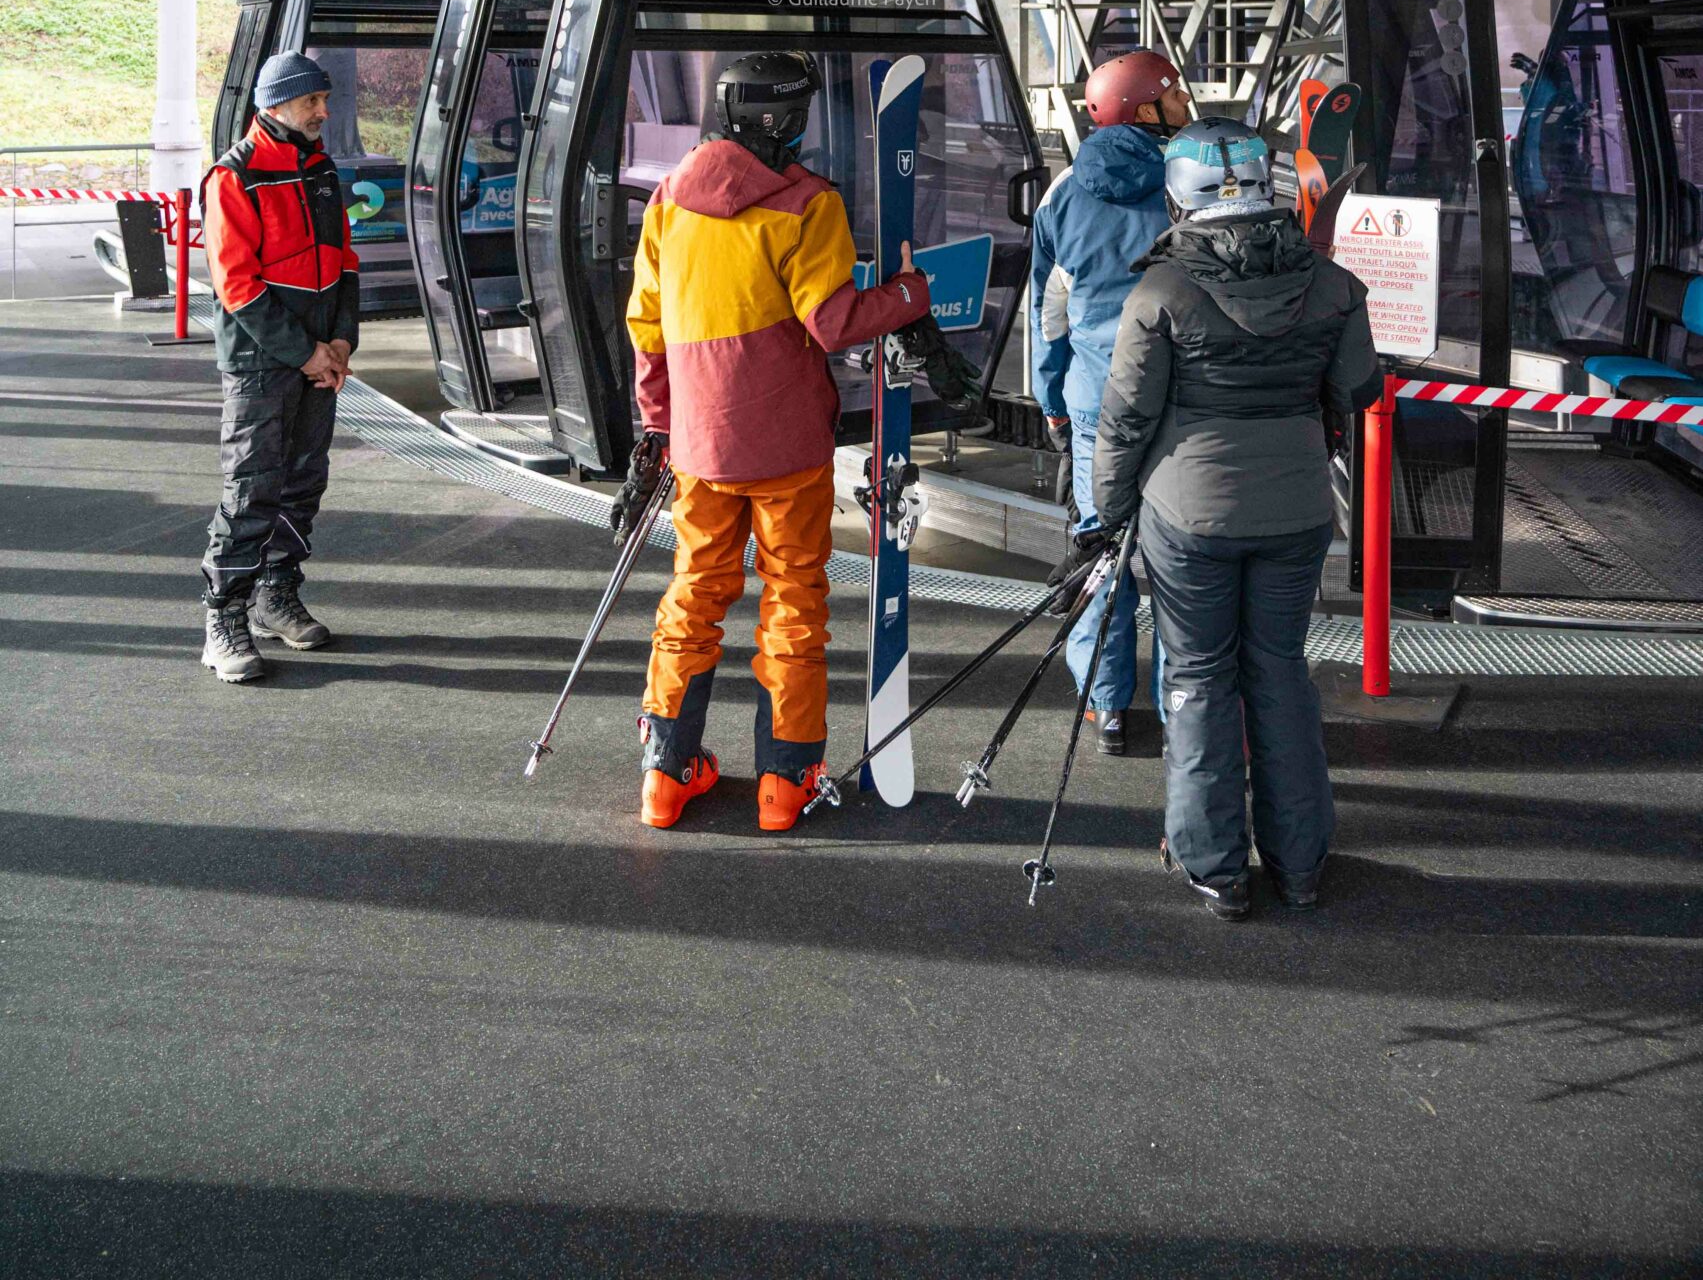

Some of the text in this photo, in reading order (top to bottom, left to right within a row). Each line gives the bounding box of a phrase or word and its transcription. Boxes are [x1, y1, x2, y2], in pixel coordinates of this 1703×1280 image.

[481, 187, 517, 208] Ag
[480, 210, 515, 222] avec
[1339, 235, 1424, 249] MERCI DE RESTER ASSIS
[1336, 246, 1367, 255] ENDANT
[1369, 248, 1393, 257] TOUTE
[1394, 250, 1404, 258] LA
[1344, 256, 1356, 264] DU
[1384, 270, 1398, 278] DES
[1400, 271, 1429, 281] PORTES
[930, 302, 962, 318] ous
[1395, 302, 1424, 312] SEATED
[1381, 311, 1409, 321] WHOLE
[1410, 313, 1427, 322] TRIP
[1398, 323, 1418, 333] OPEN
[1419, 326, 1429, 334] IN
[1391, 333, 1422, 344] STATION
